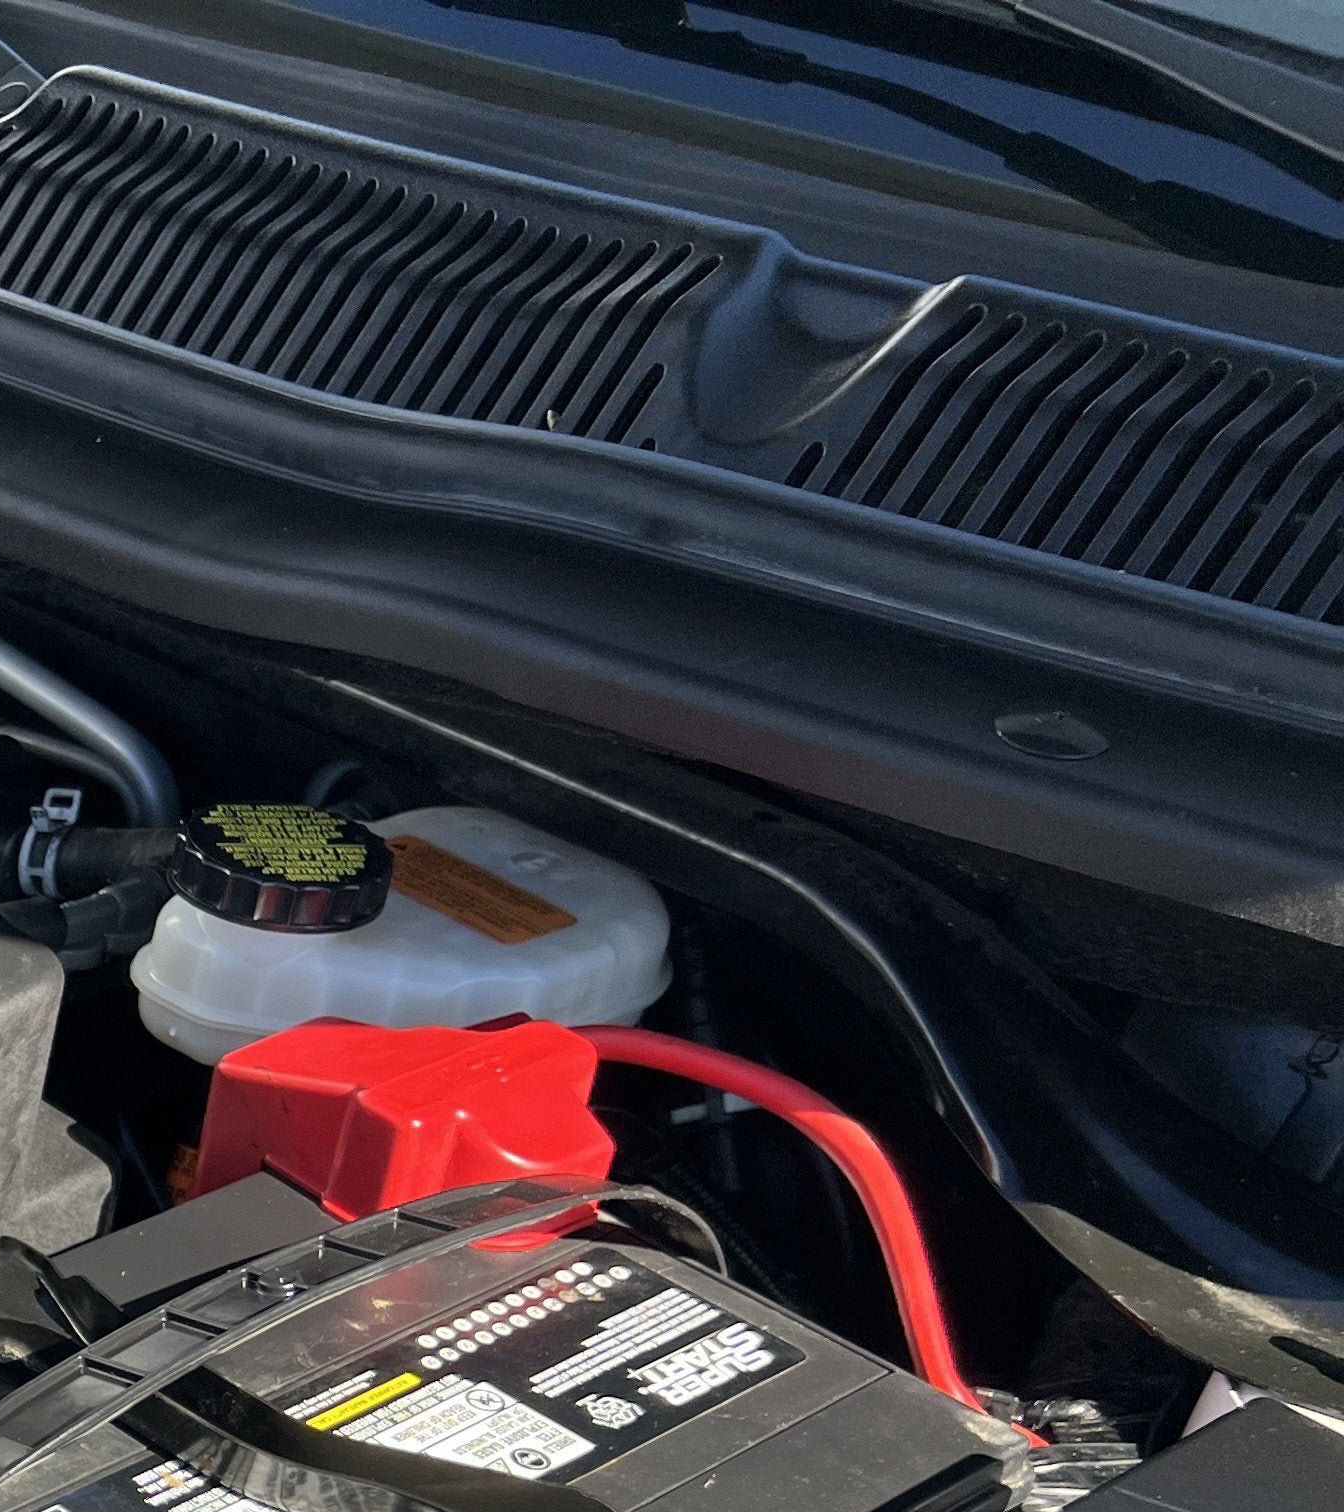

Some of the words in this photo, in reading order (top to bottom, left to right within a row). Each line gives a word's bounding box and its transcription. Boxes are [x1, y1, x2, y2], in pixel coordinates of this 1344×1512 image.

[634, 1321, 766, 1390] START
[657, 1346, 777, 1408] SUPER
[437, 1403, 467, 1418] REACH
[453, 1409, 478, 1422] KEEP
[426, 1414, 443, 1424] OF
[438, 1418, 460, 1430] OUT
[412, 1432, 433, 1443] THE
[427, 1426, 444, 1436] OF
[498, 1419, 549, 1446] EXPLOSIVE
[470, 1441, 505, 1459] GASES
[541, 1434, 577, 1454] SHIELD
